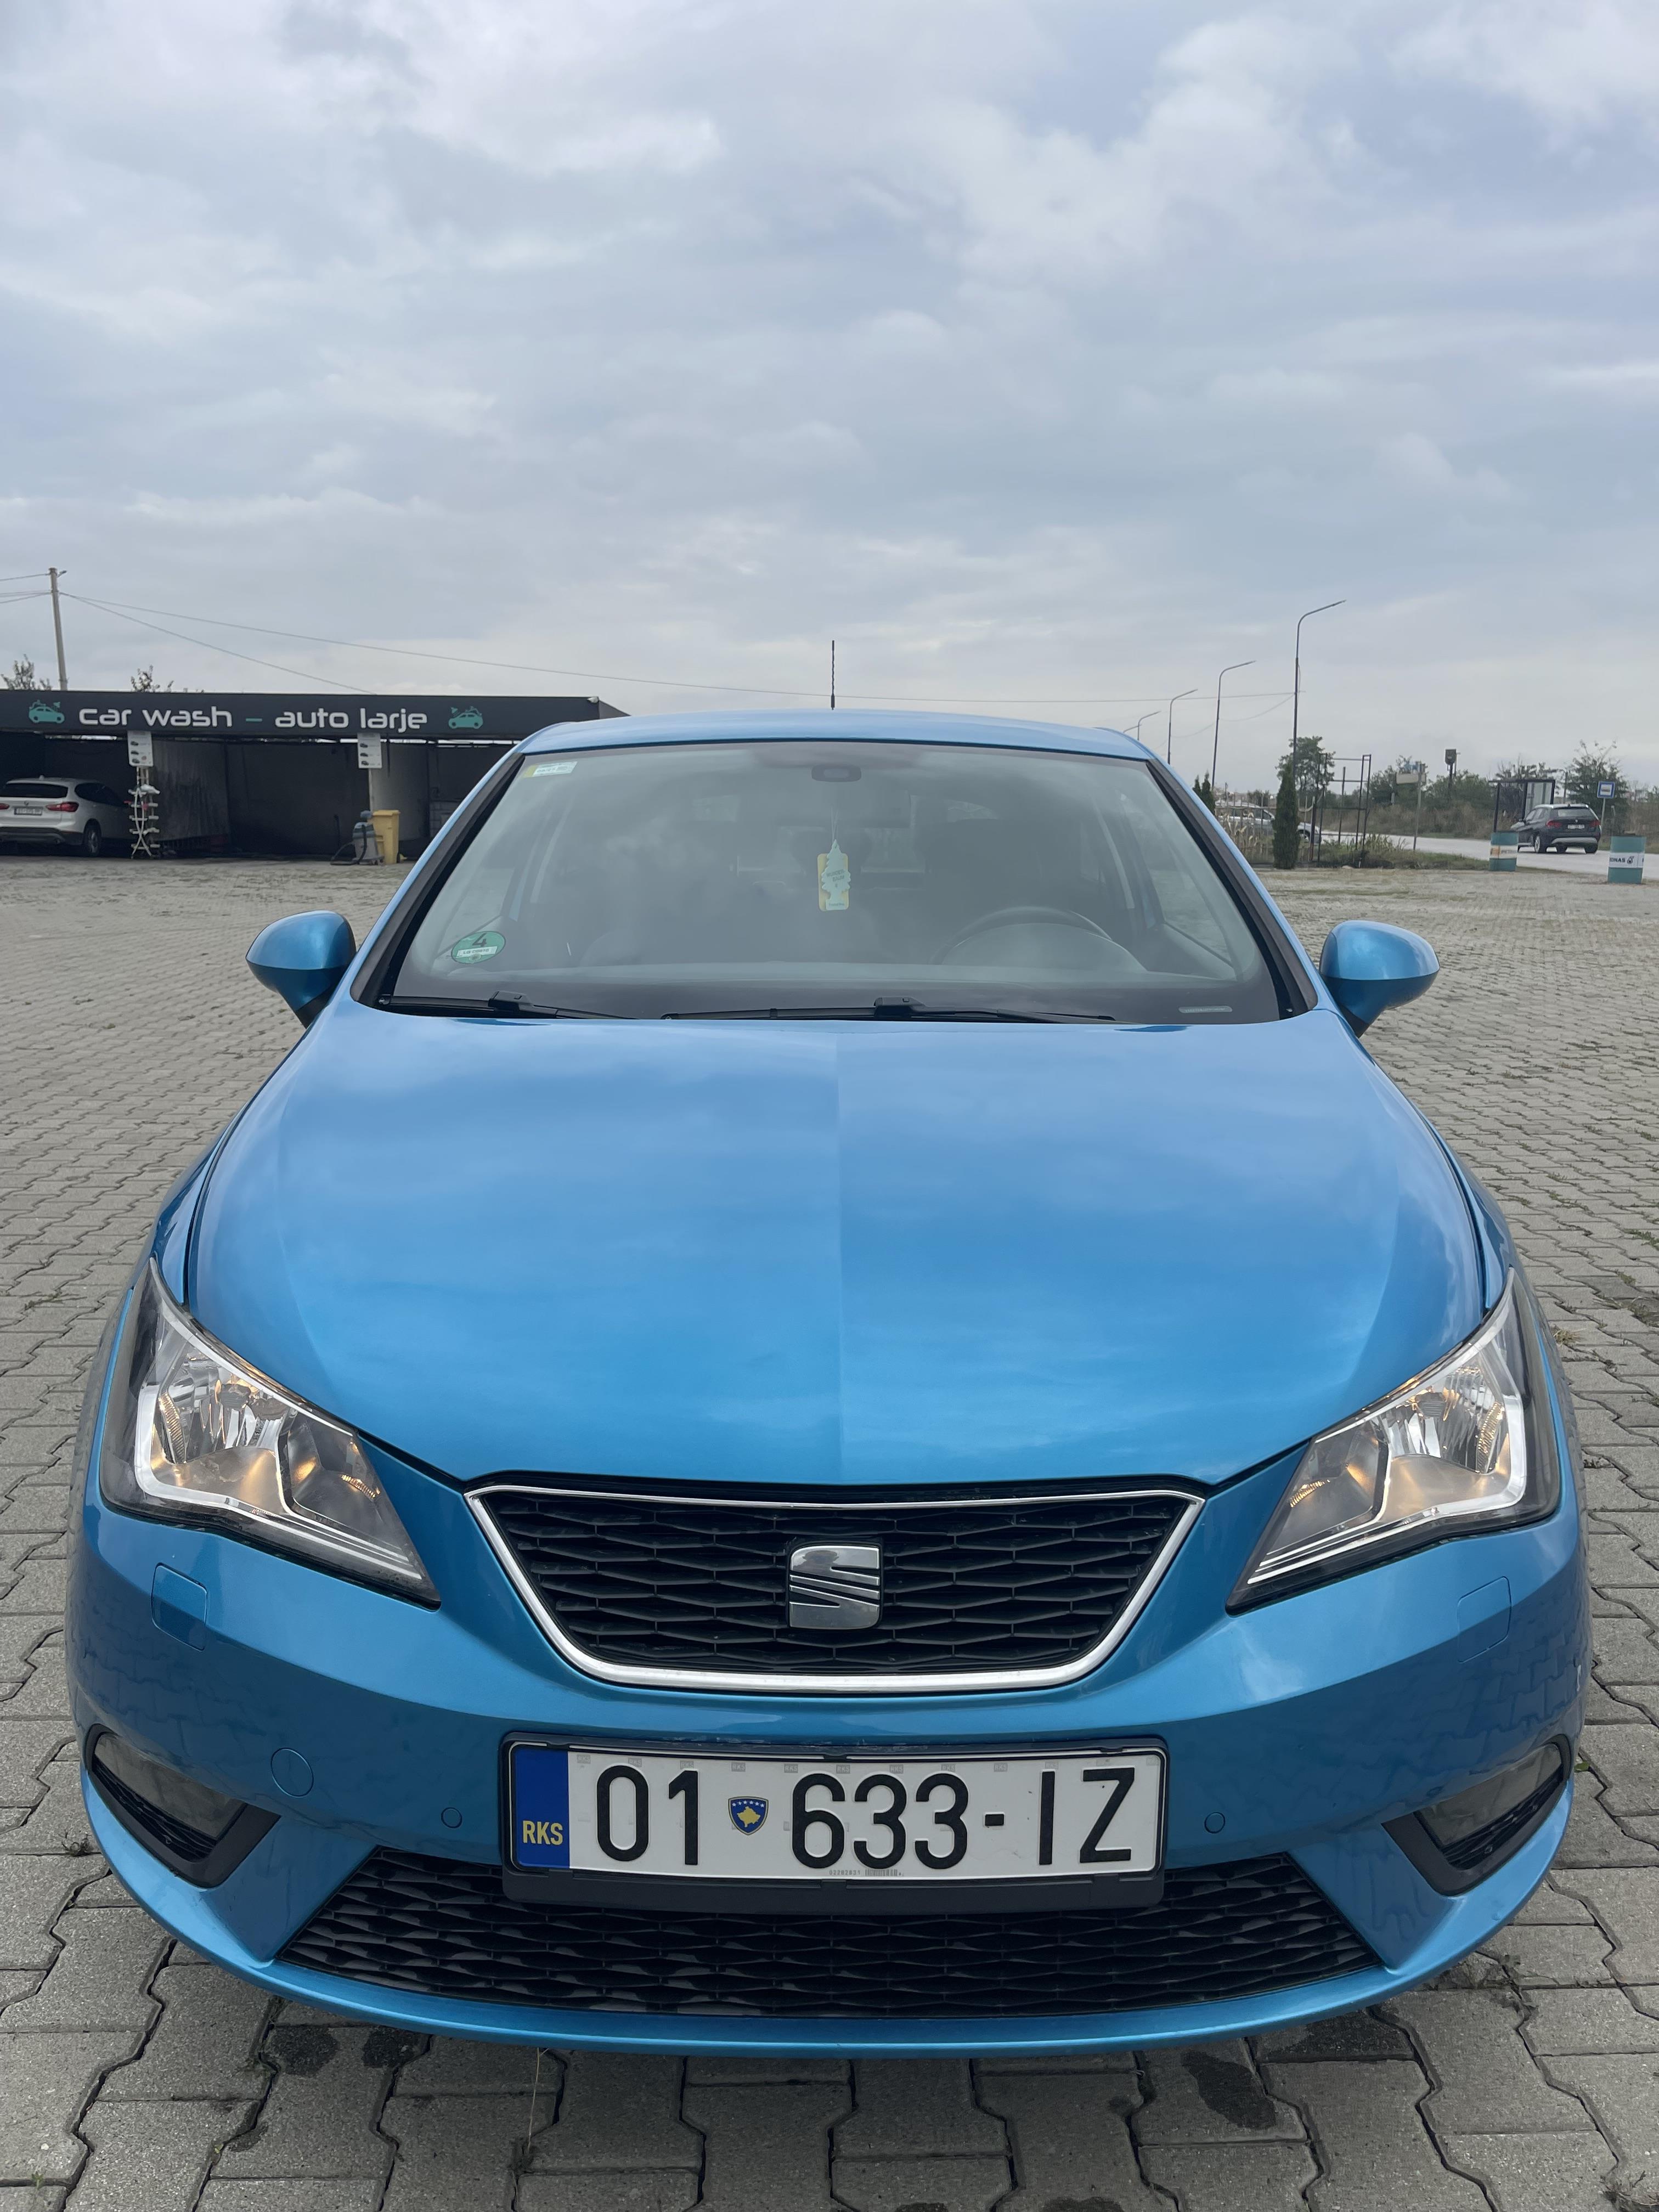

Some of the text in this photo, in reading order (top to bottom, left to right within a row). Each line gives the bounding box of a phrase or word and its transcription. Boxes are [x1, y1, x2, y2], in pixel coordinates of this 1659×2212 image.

[79, 708, 132, 726] car
[142, 706, 232, 727] wash
[275, 708, 349, 728] auto
[360, 708, 427, 733] larje
[472, 933, 487, 948] 4
[522, 1820, 563, 1846] RKS
[596, 1764, 698, 1865] 01
